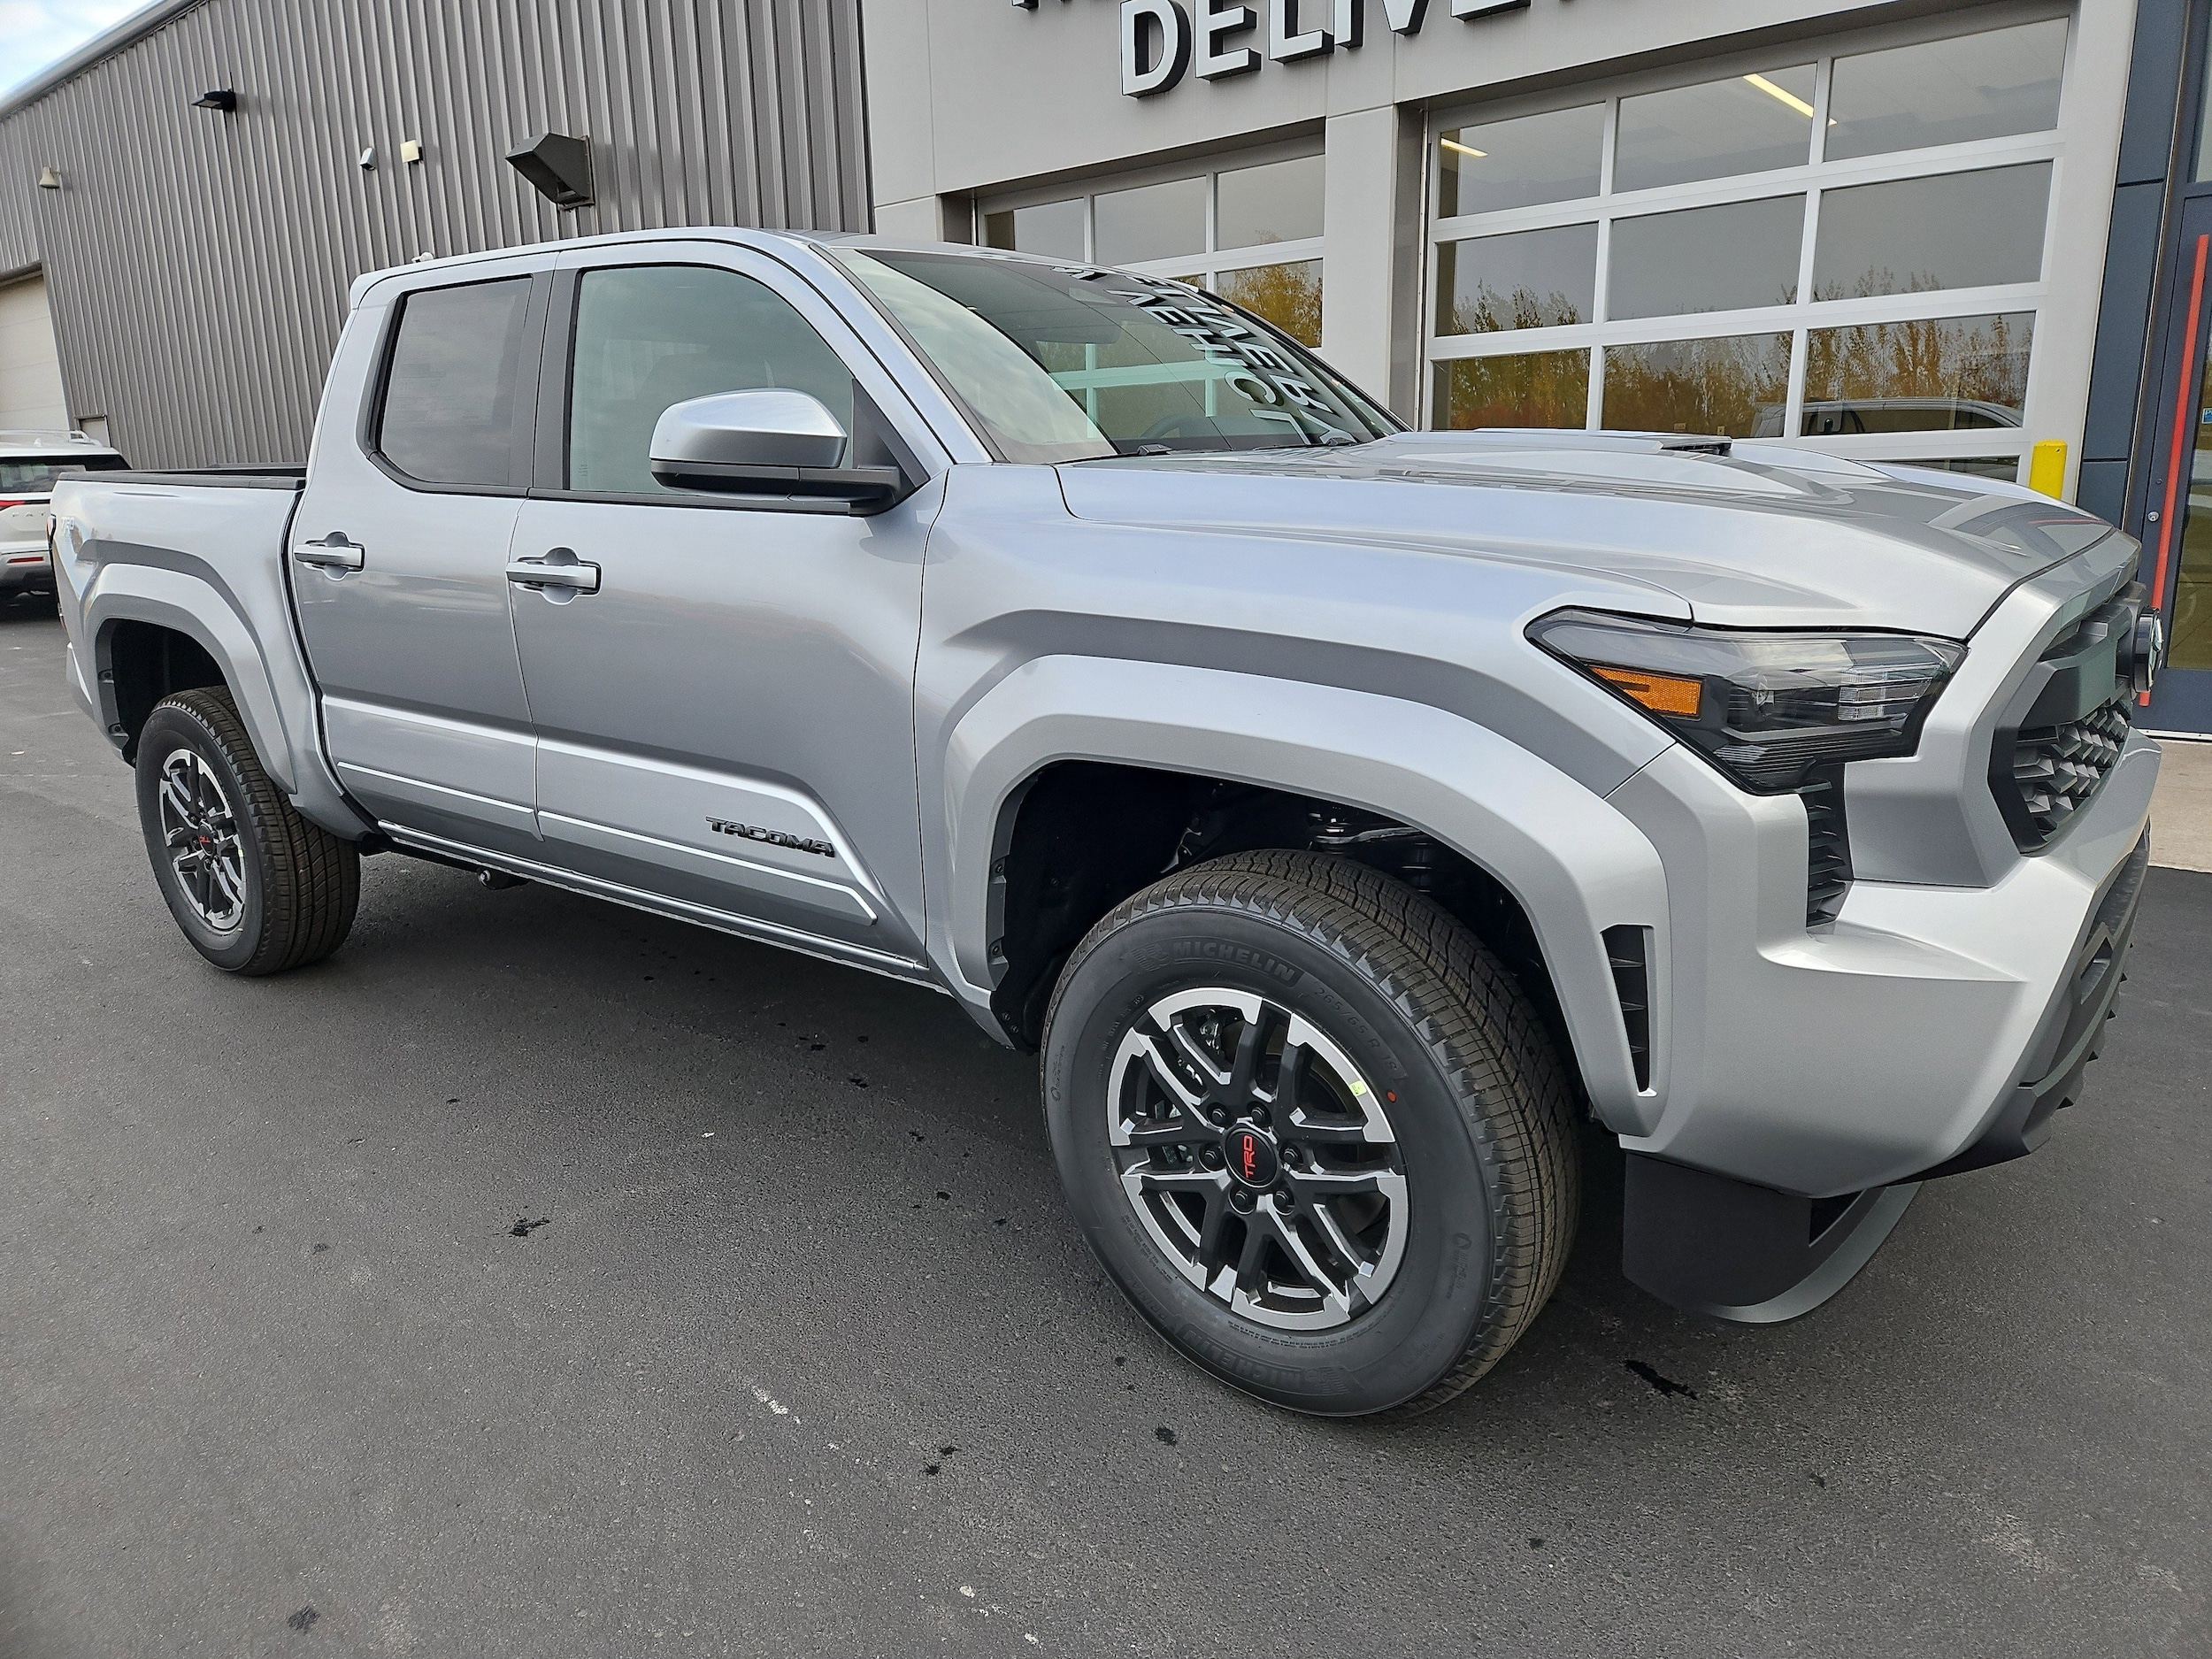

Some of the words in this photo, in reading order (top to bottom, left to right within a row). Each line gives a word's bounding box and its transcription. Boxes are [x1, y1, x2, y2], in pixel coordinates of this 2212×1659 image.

[705, 816, 835, 858] TACOMA
[1173, 941, 1296, 982] MICHELIN
[1314, 986, 1369, 1034] 265/65
[1243, 1134, 1256, 1179] TRD
[1182, 1329, 1302, 1387] MICHELIN
